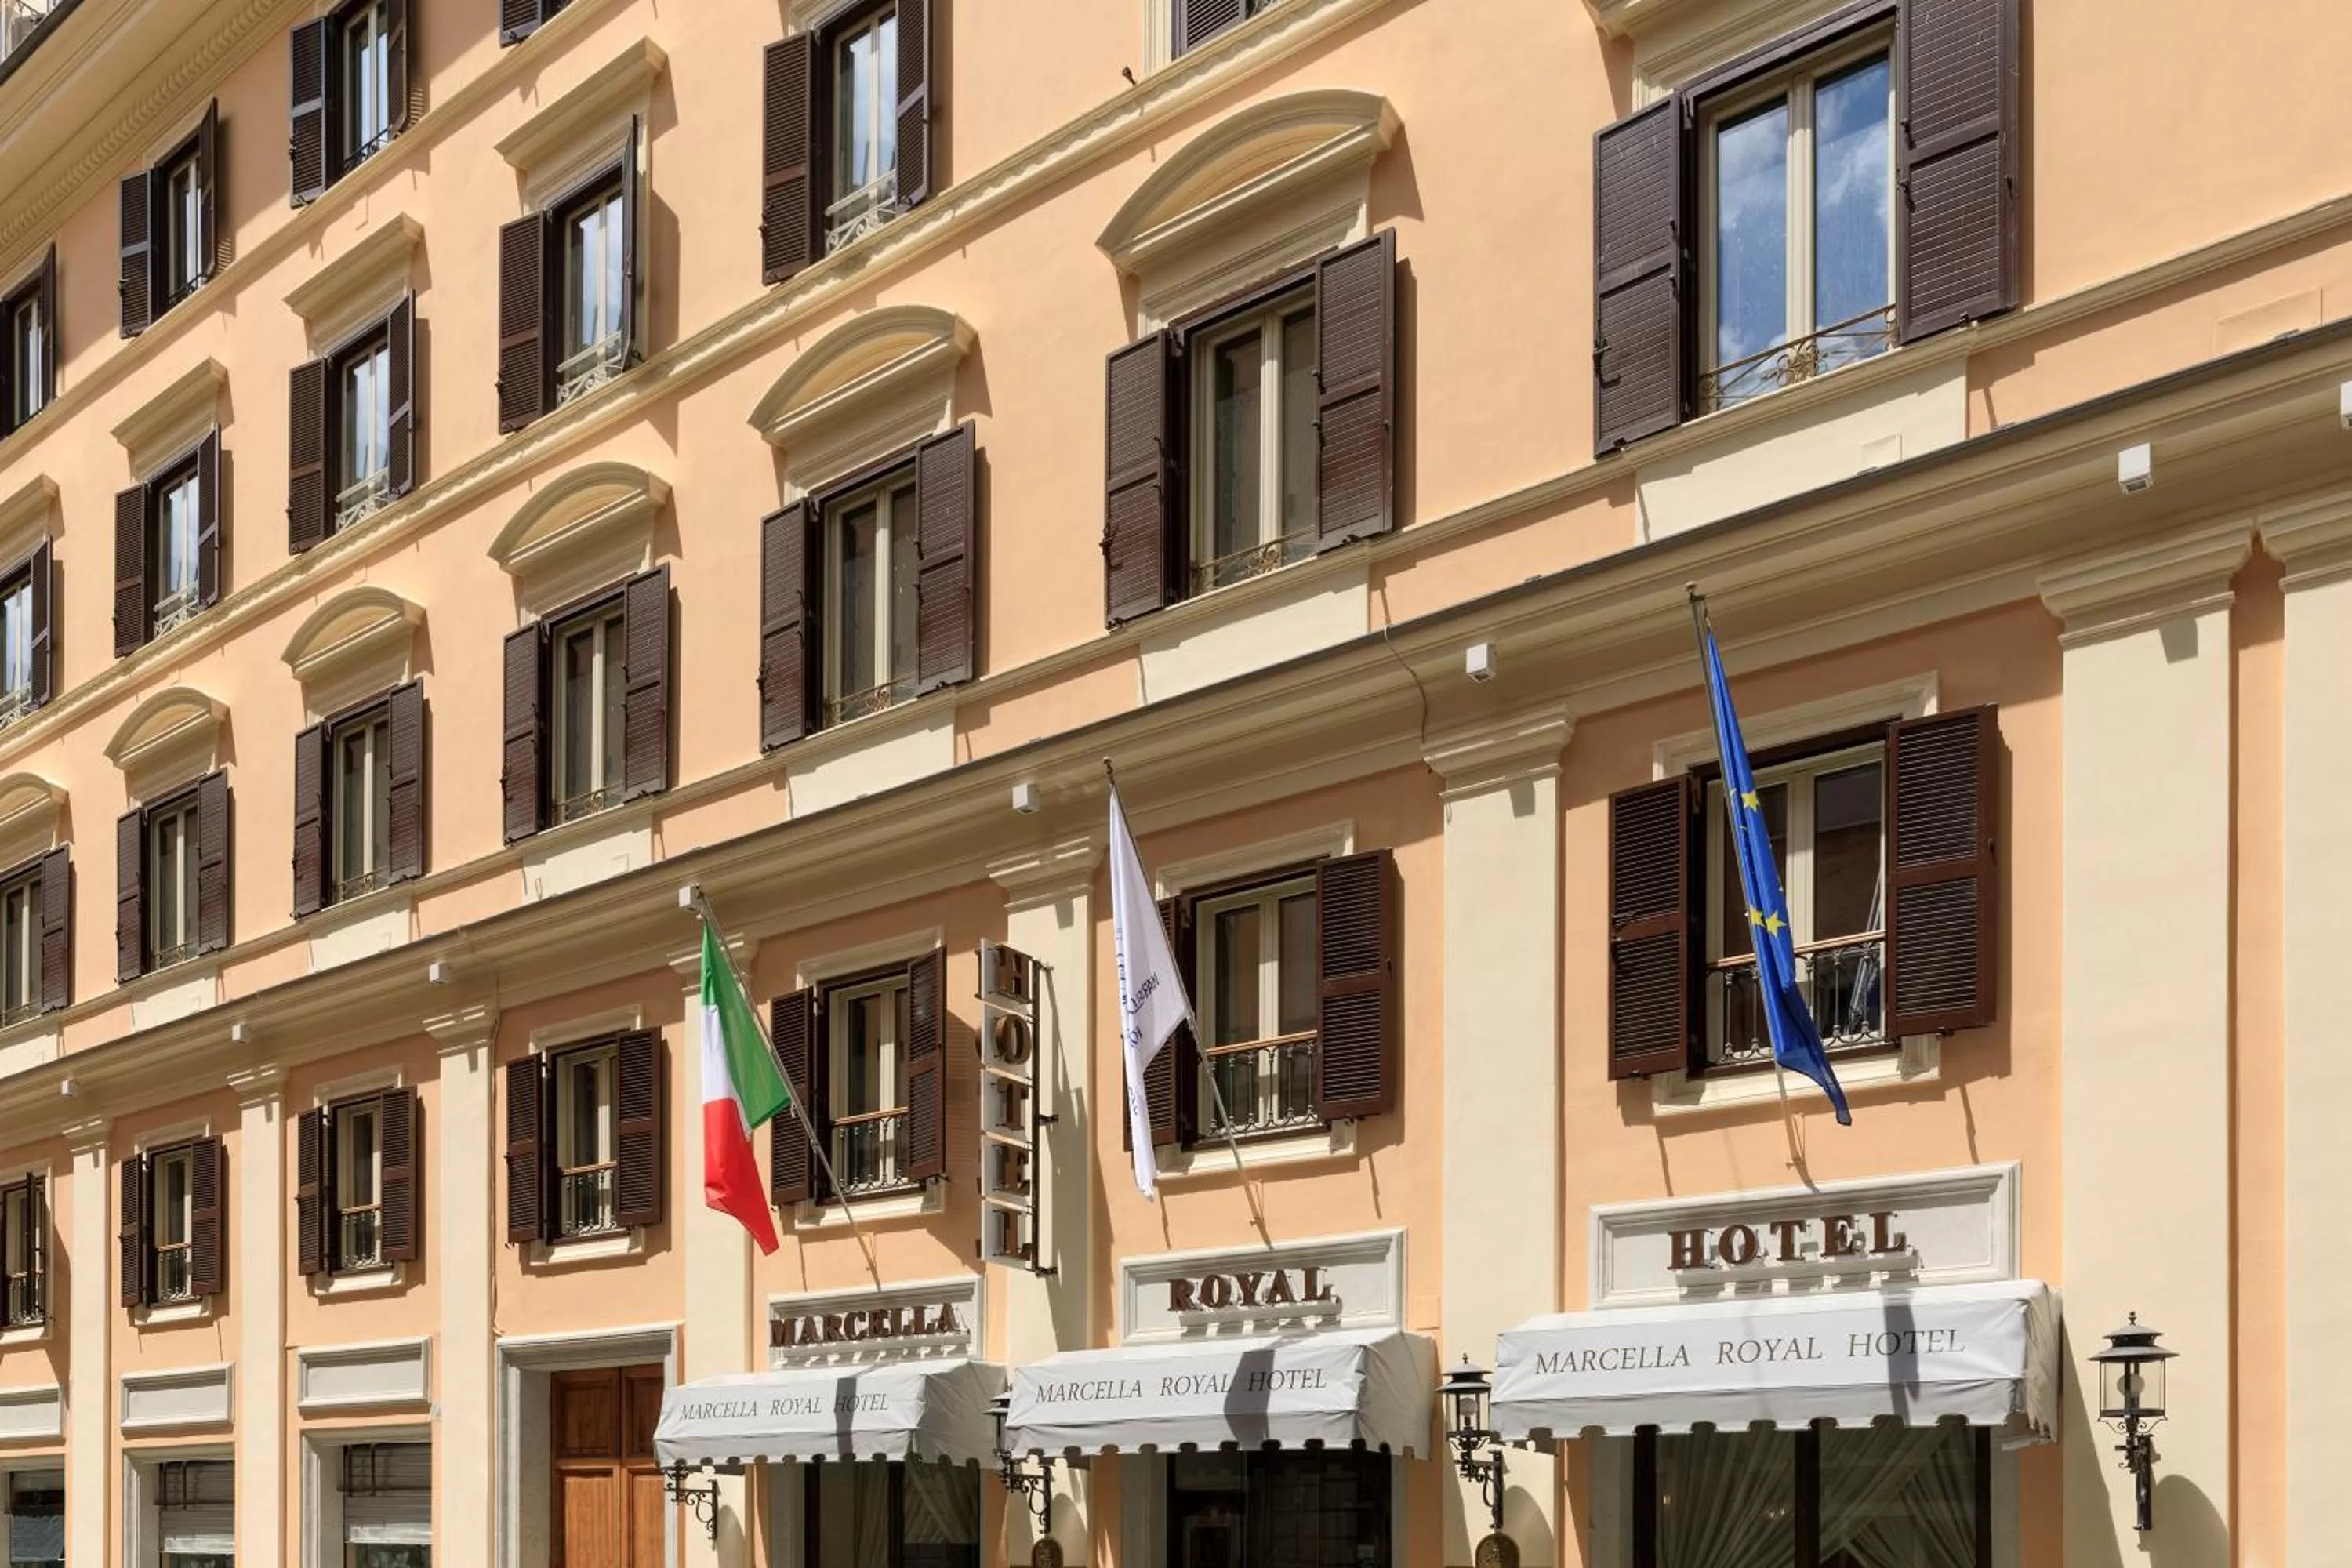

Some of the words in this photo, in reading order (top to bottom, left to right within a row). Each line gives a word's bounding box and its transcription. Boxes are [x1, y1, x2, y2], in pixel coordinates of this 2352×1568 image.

[1667, 1212, 1907, 1269] HOTEL
[1167, 1267, 1335, 1312] ROYAL
[769, 1302, 961, 1348] MARCELLA
[1534, 1344, 1691, 1374] MARCELLA
[1716, 1336, 1824, 1365] ROYAL
[1846, 1328, 1966, 1357] HOTEL
[679, 1401, 758, 1421] MARCELLA
[769, 1396, 823, 1416] ROYAL
[833, 1393, 889, 1414] HOTEL
[1035, 1379, 1142, 1403] MARCELLA
[1159, 1374, 1233, 1397] ROYAL
[1247, 1367, 1327, 1392] HOTEL
